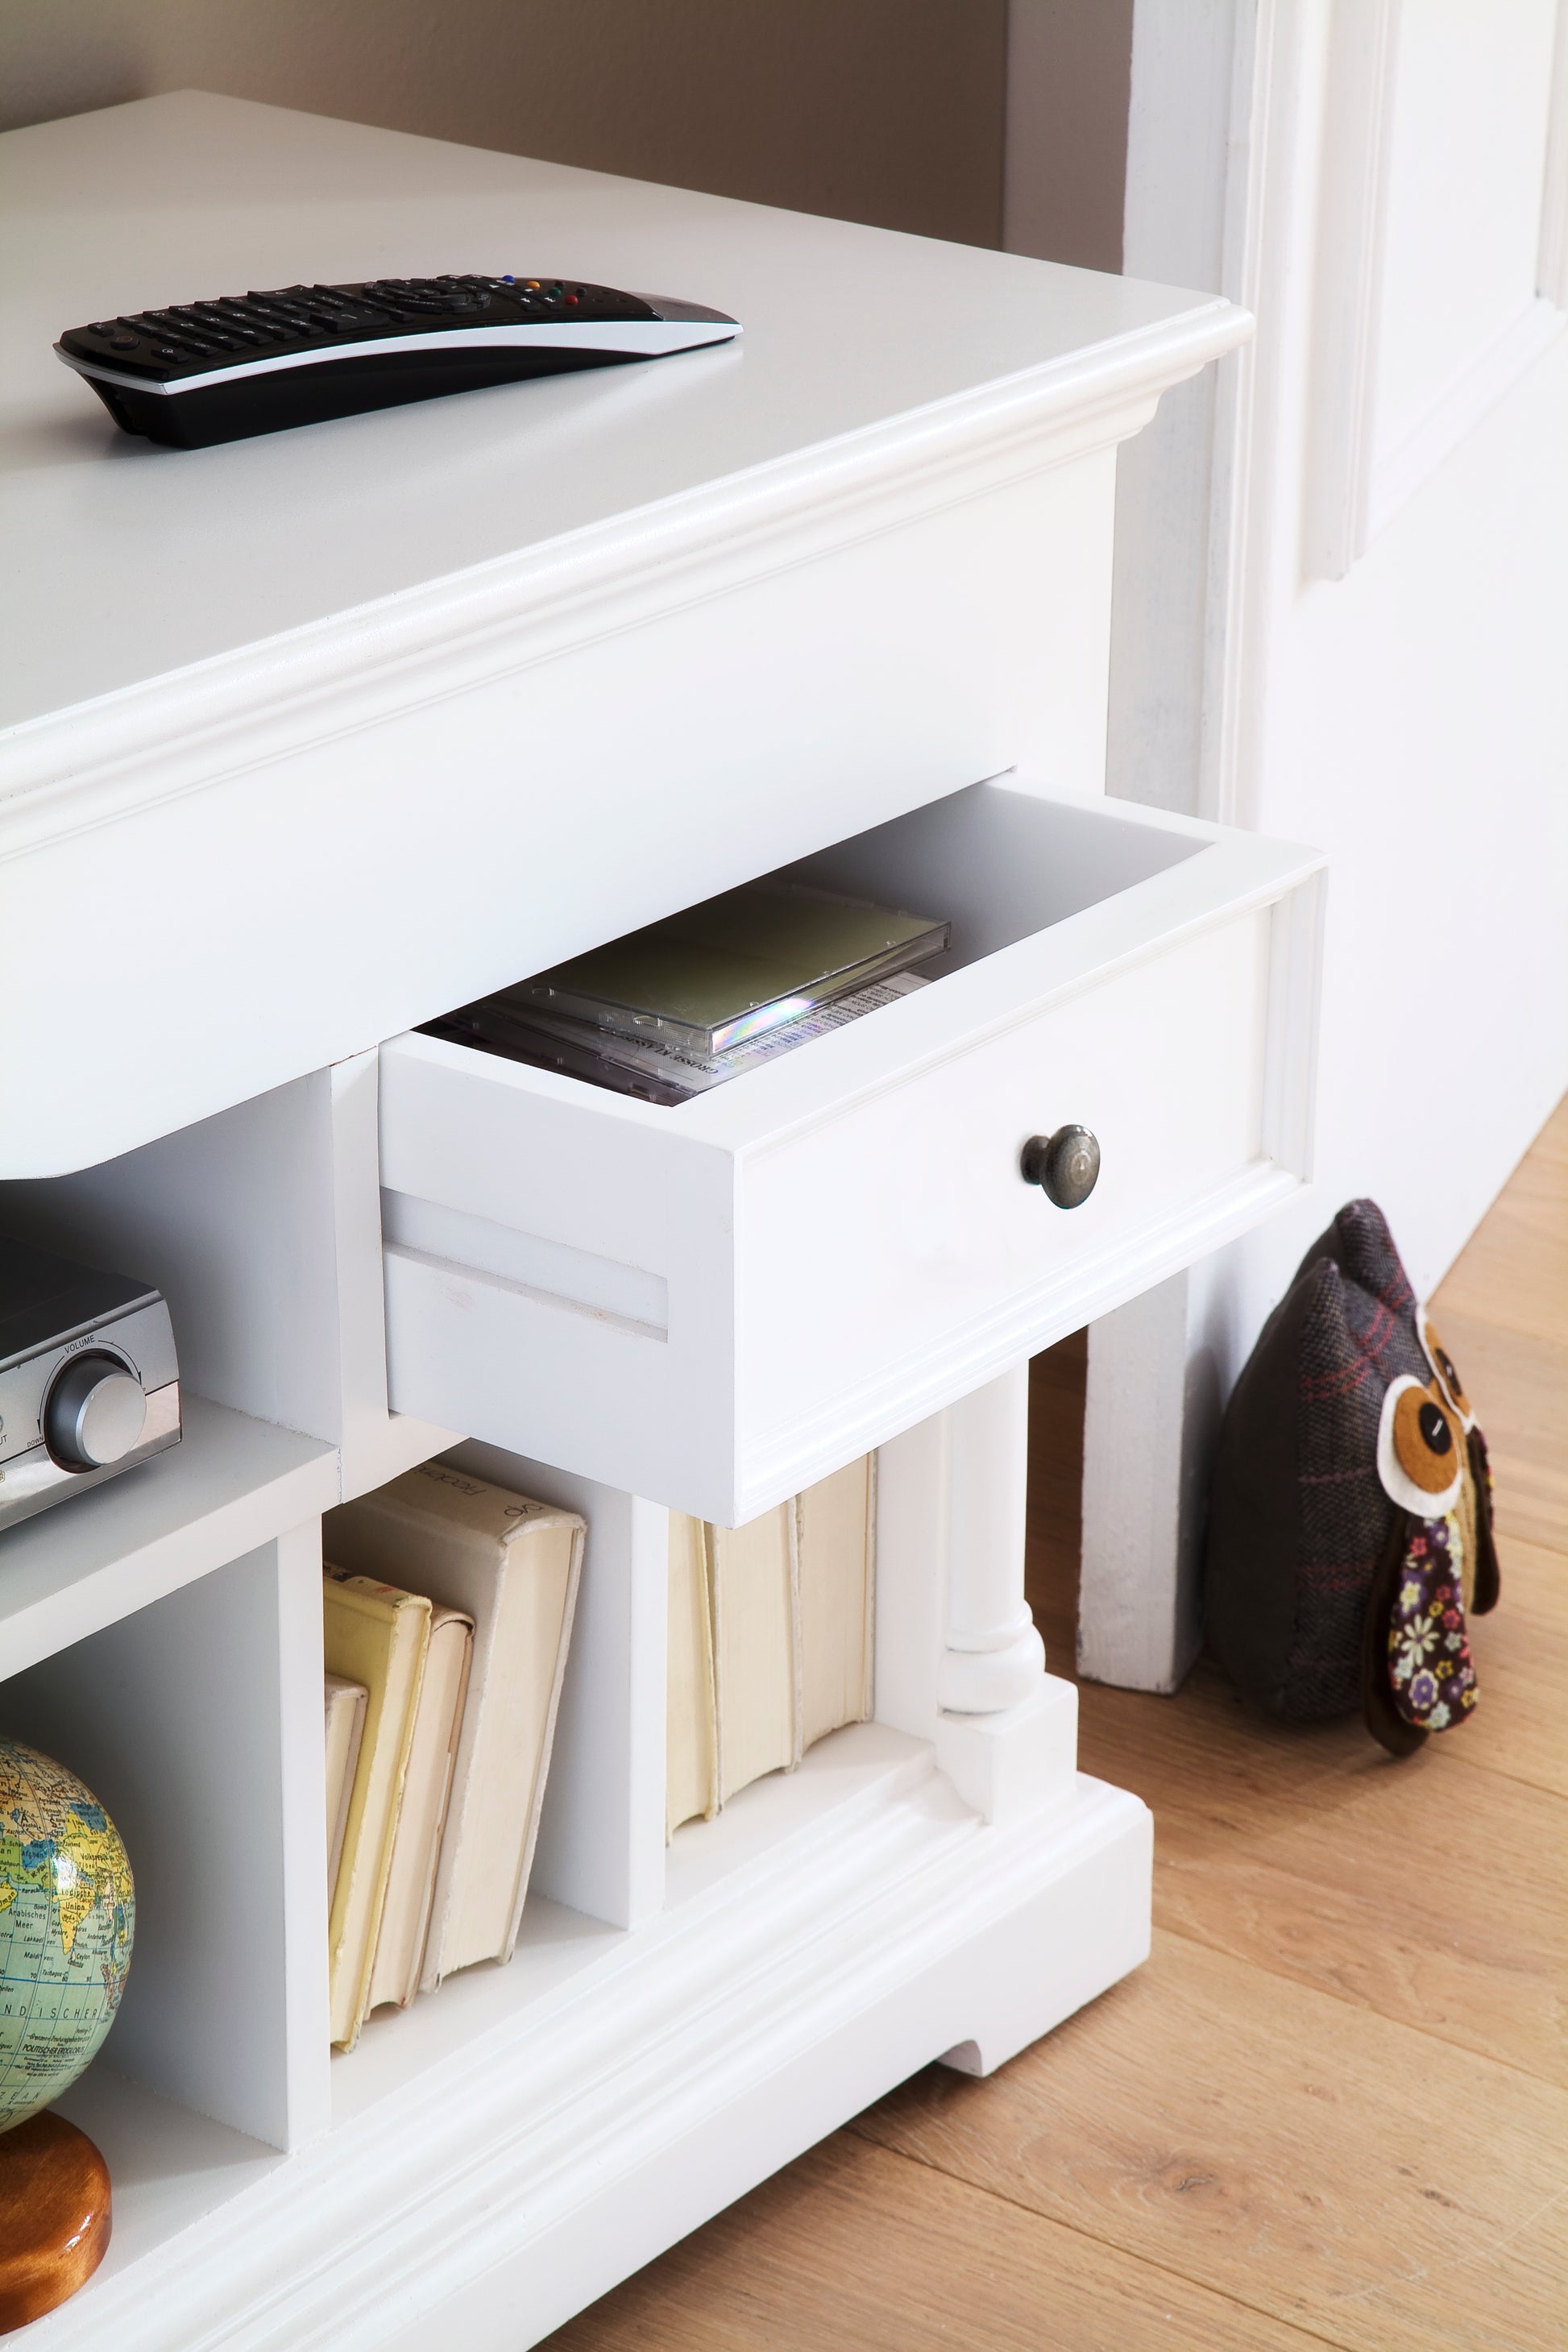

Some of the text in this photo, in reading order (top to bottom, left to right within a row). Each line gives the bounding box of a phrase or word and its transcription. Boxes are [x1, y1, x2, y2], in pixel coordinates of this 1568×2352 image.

[64, 1335, 95, 1354] VOLUME
[27, 1436, 44, 1448] DOWN
[65, 1902, 85, 1910] Union
[8, 1907, 46, 1919] Arabisches
[15, 1919, 33, 1929] Meer
[77, 1953, 90, 1961] Ceylon
